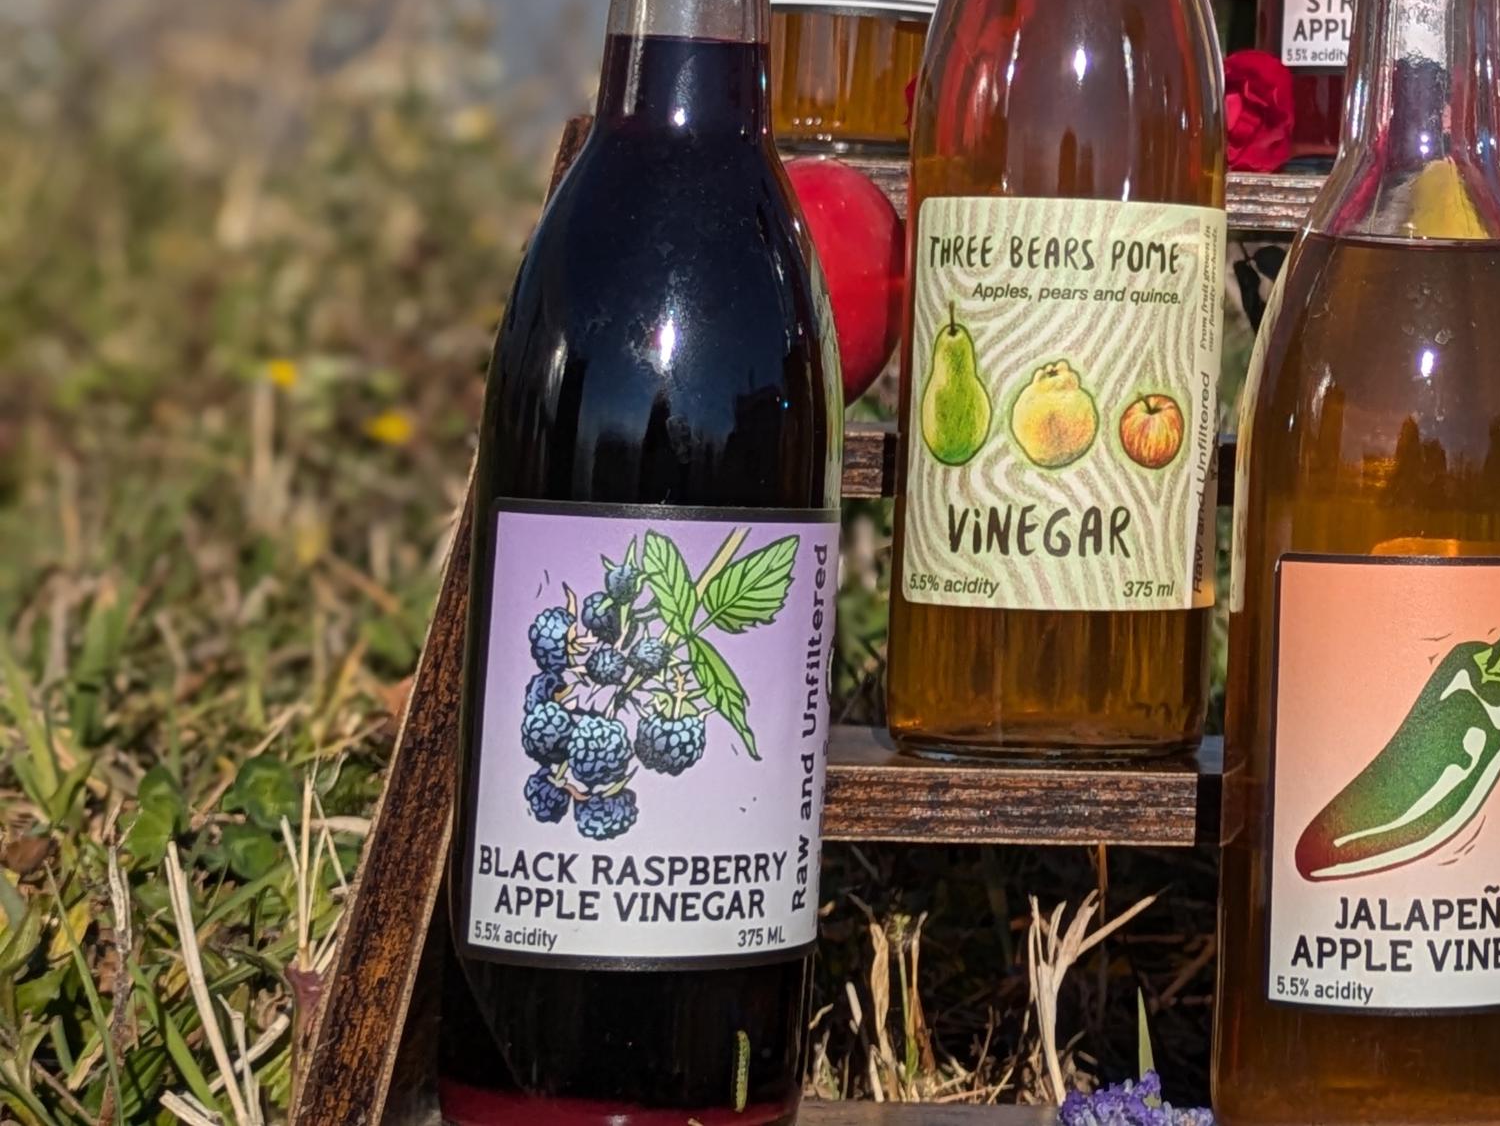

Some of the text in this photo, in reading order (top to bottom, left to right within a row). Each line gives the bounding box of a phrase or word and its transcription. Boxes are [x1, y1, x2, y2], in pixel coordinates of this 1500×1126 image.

[1293, 18, 1350, 42] APPL
[1286, 48, 1307, 62] 5.5%
[929, 235, 1180, 274] THREE BEARS POME
[972, 283, 1182, 305] Apples, pears and quince.
[1196, 371, 1210, 483] Unfiltered
[1193, 541, 1203, 593] Raw
[909, 574, 1175, 599] 5.5% acidity 375 ml
[803, 544, 828, 738] Unfiltered
[800, 752, 815, 821] and
[478, 844, 787, 886] BLACK RASPBERRY
[792, 834, 810, 912] Raw
[494, 884, 765, 922] APPLE VINEGAR
[474, 920, 786, 951] 5.5% acidity 375 ML
[1291, 934, 1413, 972] APPLE
[1276, 975, 1309, 997] 5.5%
[1314, 981, 1374, 1005] acidity
